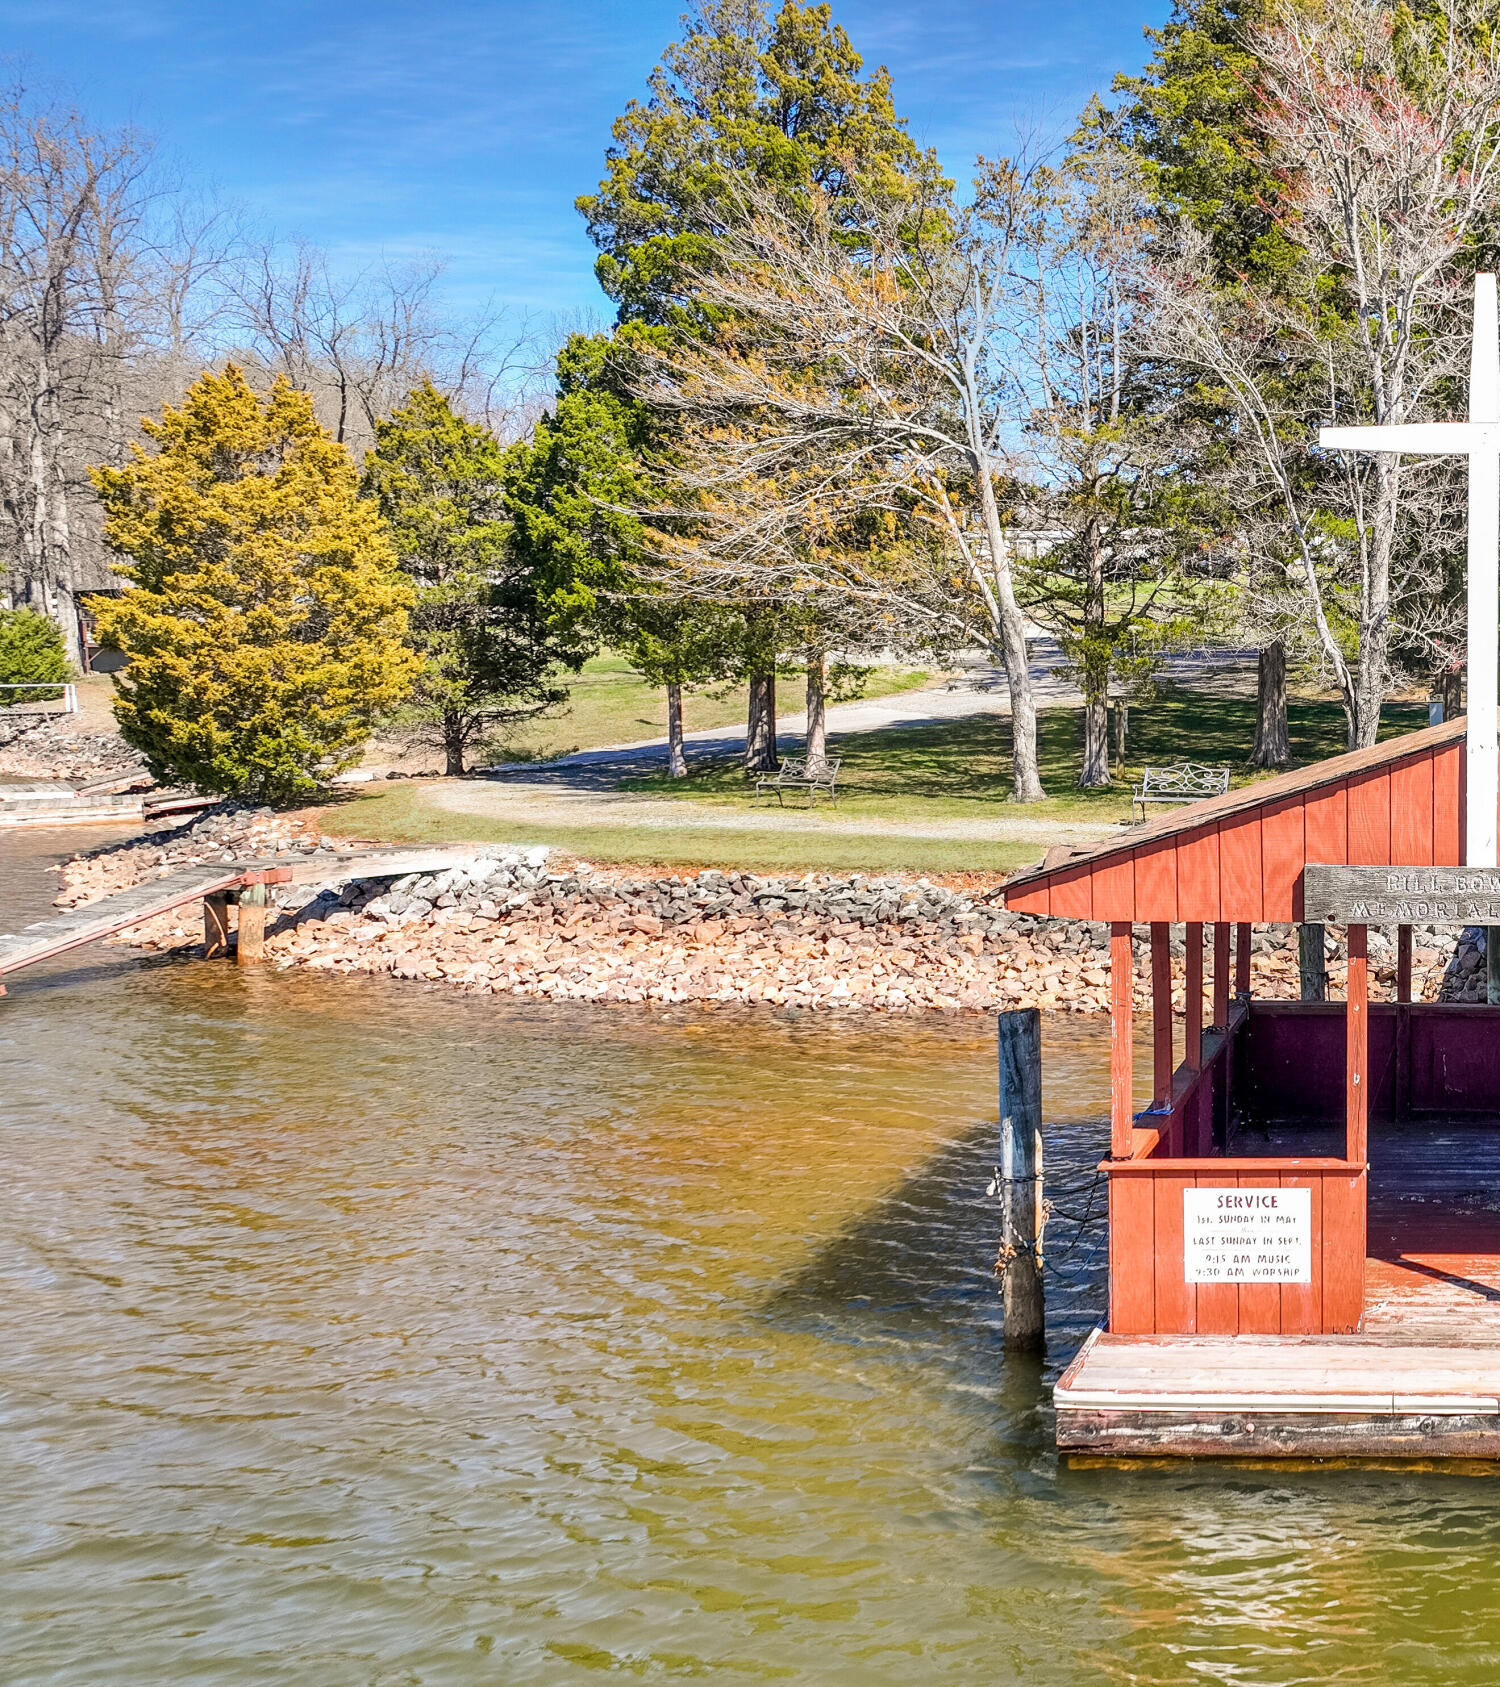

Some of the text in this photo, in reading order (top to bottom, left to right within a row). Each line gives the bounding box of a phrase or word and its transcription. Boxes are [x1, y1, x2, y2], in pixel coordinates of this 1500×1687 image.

[1385, 873, 1443, 894] BILL
[1351, 900, 1500, 919] MEMORIAL
[1216, 1195, 1279, 1208] SERVICE
[1218, 1215, 1255, 1224] SUNDAY
[1260, 1215, 1271, 1224] IN
[1275, 1215, 1297, 1224] MAY
[1192, 1236, 1216, 1245] LAST
[1220, 1236, 1257, 1245] SUNDAY
[1263, 1236, 1273, 1245] IN
[1232, 1254, 1251, 1264] AM
[1257, 1254, 1292, 1264] MUSIC
[1226, 1267, 1245, 1277] AM
[1252, 1267, 1300, 1277] WORSHIP
